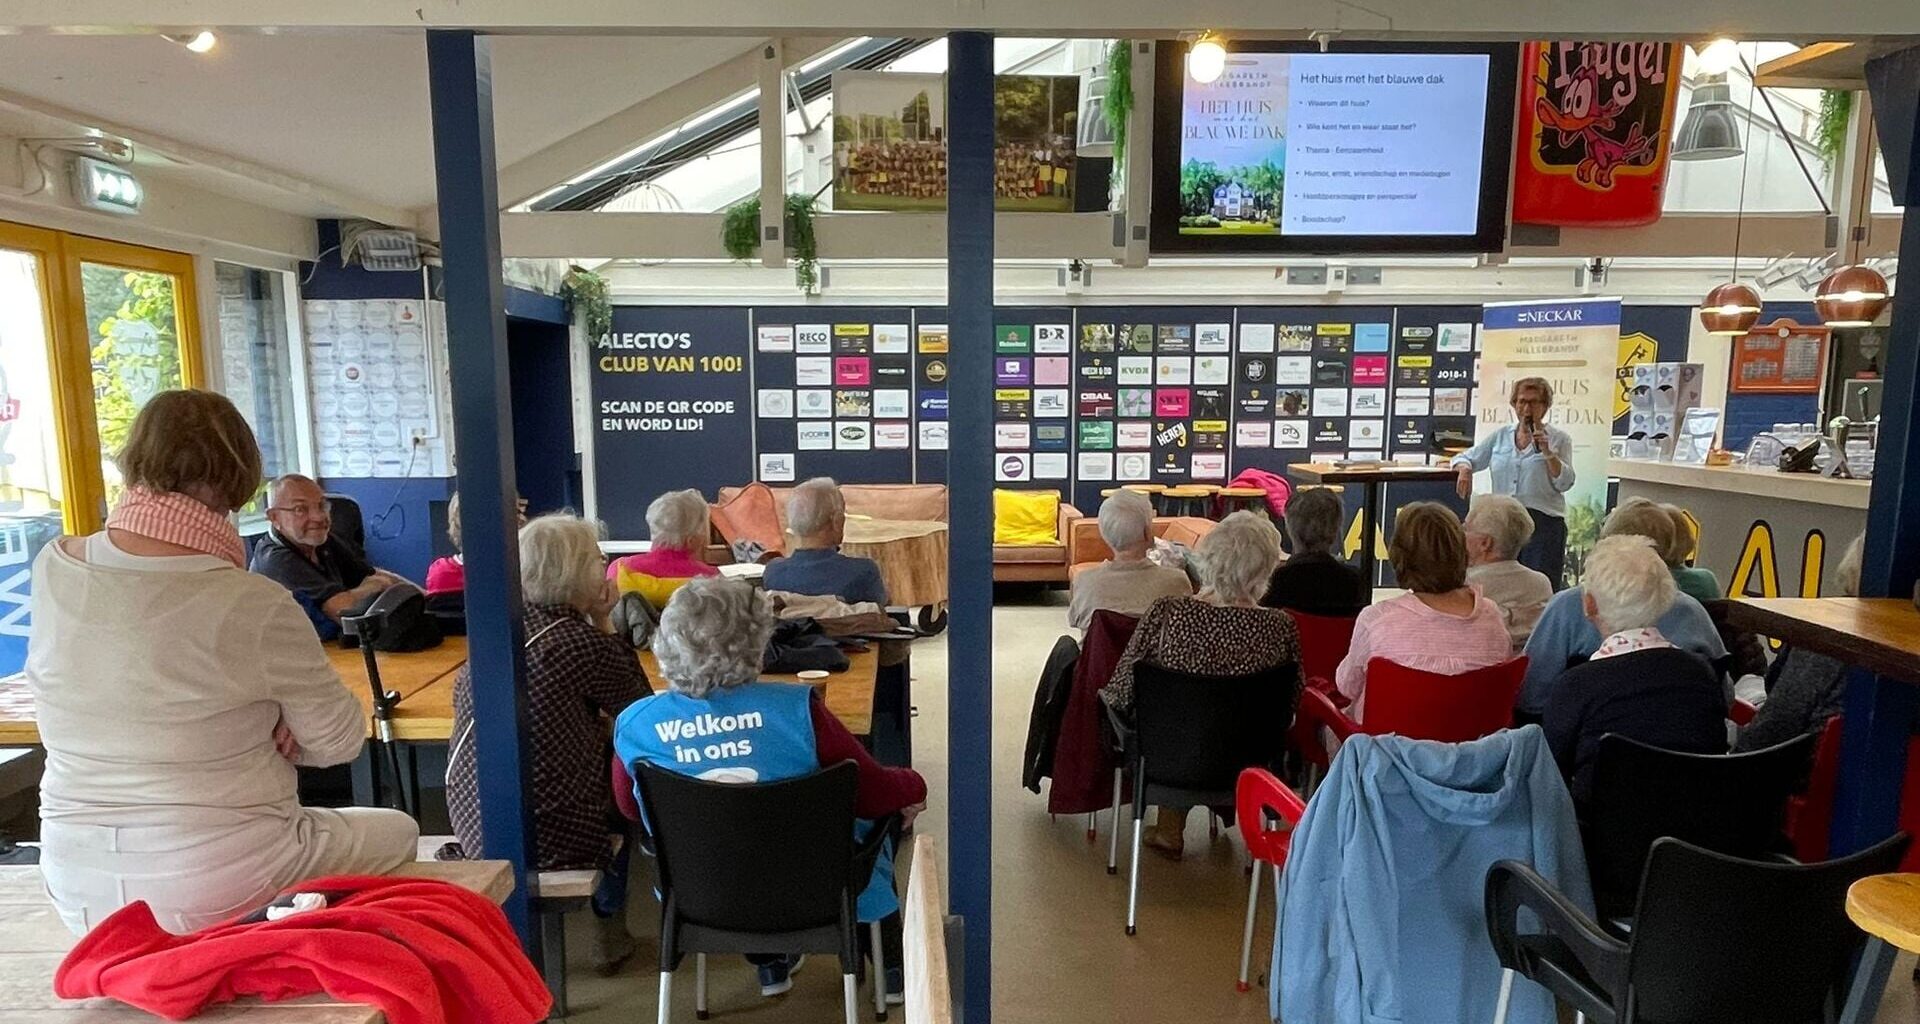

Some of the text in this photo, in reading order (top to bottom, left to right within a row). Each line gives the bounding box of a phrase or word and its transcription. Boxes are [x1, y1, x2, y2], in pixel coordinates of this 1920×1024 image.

[1301, 73, 1445, 84] Het huis met het blauwe dak
[1201, 100, 1272, 114] HET HUIS
[1185, 125, 1285, 139] BLAUWE DAK
[1305, 146, 1330, 154] Thema
[1527, 309, 1583, 323] NECKAR
[598, 332, 692, 350] ALECTO'S
[799, 332, 827, 342] RECO
[599, 356, 743, 372] CLUB VAN 100!
[601, 401, 735, 414] SCAN DE QR CODE
[1566, 408, 1605, 424] DAK
[602, 418, 704, 431] EN WORD LID!
[654, 710, 764, 744] Welkom
[675, 738, 753, 764] in ons
